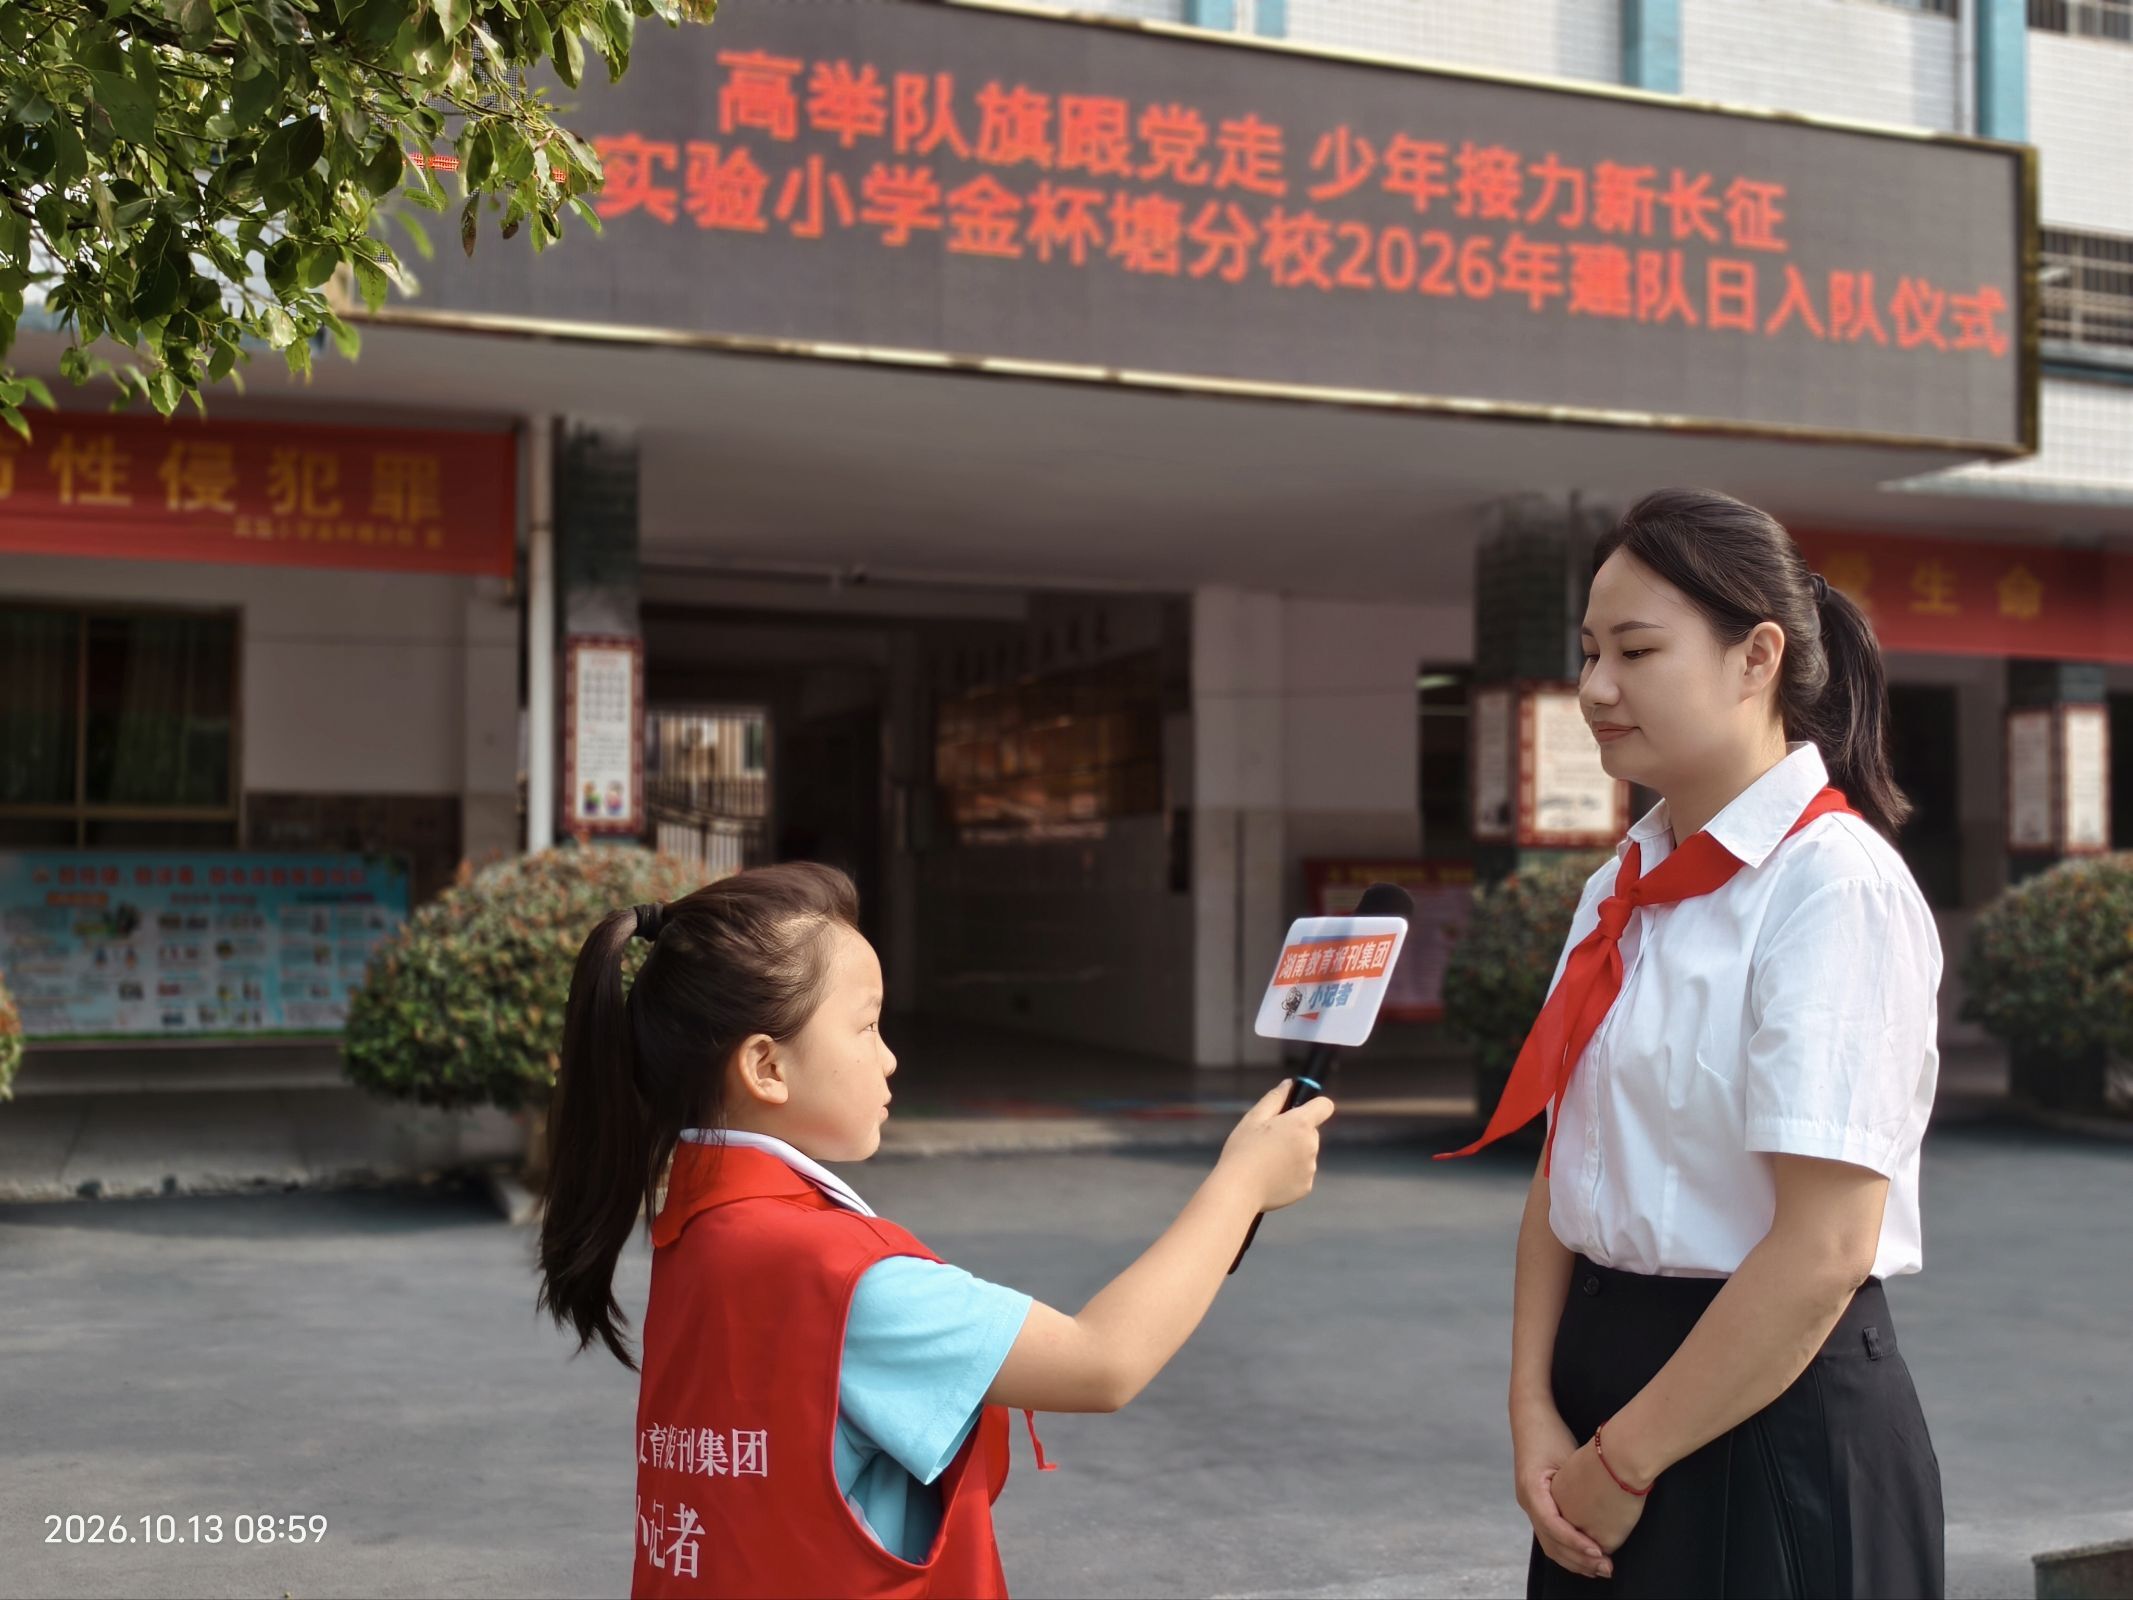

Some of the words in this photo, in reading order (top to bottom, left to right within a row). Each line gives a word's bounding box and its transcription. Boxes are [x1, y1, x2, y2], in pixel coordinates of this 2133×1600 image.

[716, 48, 1287, 197] 高举队旗跟党走
[1308, 127, 1788, 252] 少年接力新长征
[0, 432, 442, 521] 性侵犯罪
[1279, 940, 1392, 979] 湖南教育报刊集团
[1308, 982, 1355, 1010] 小记者
